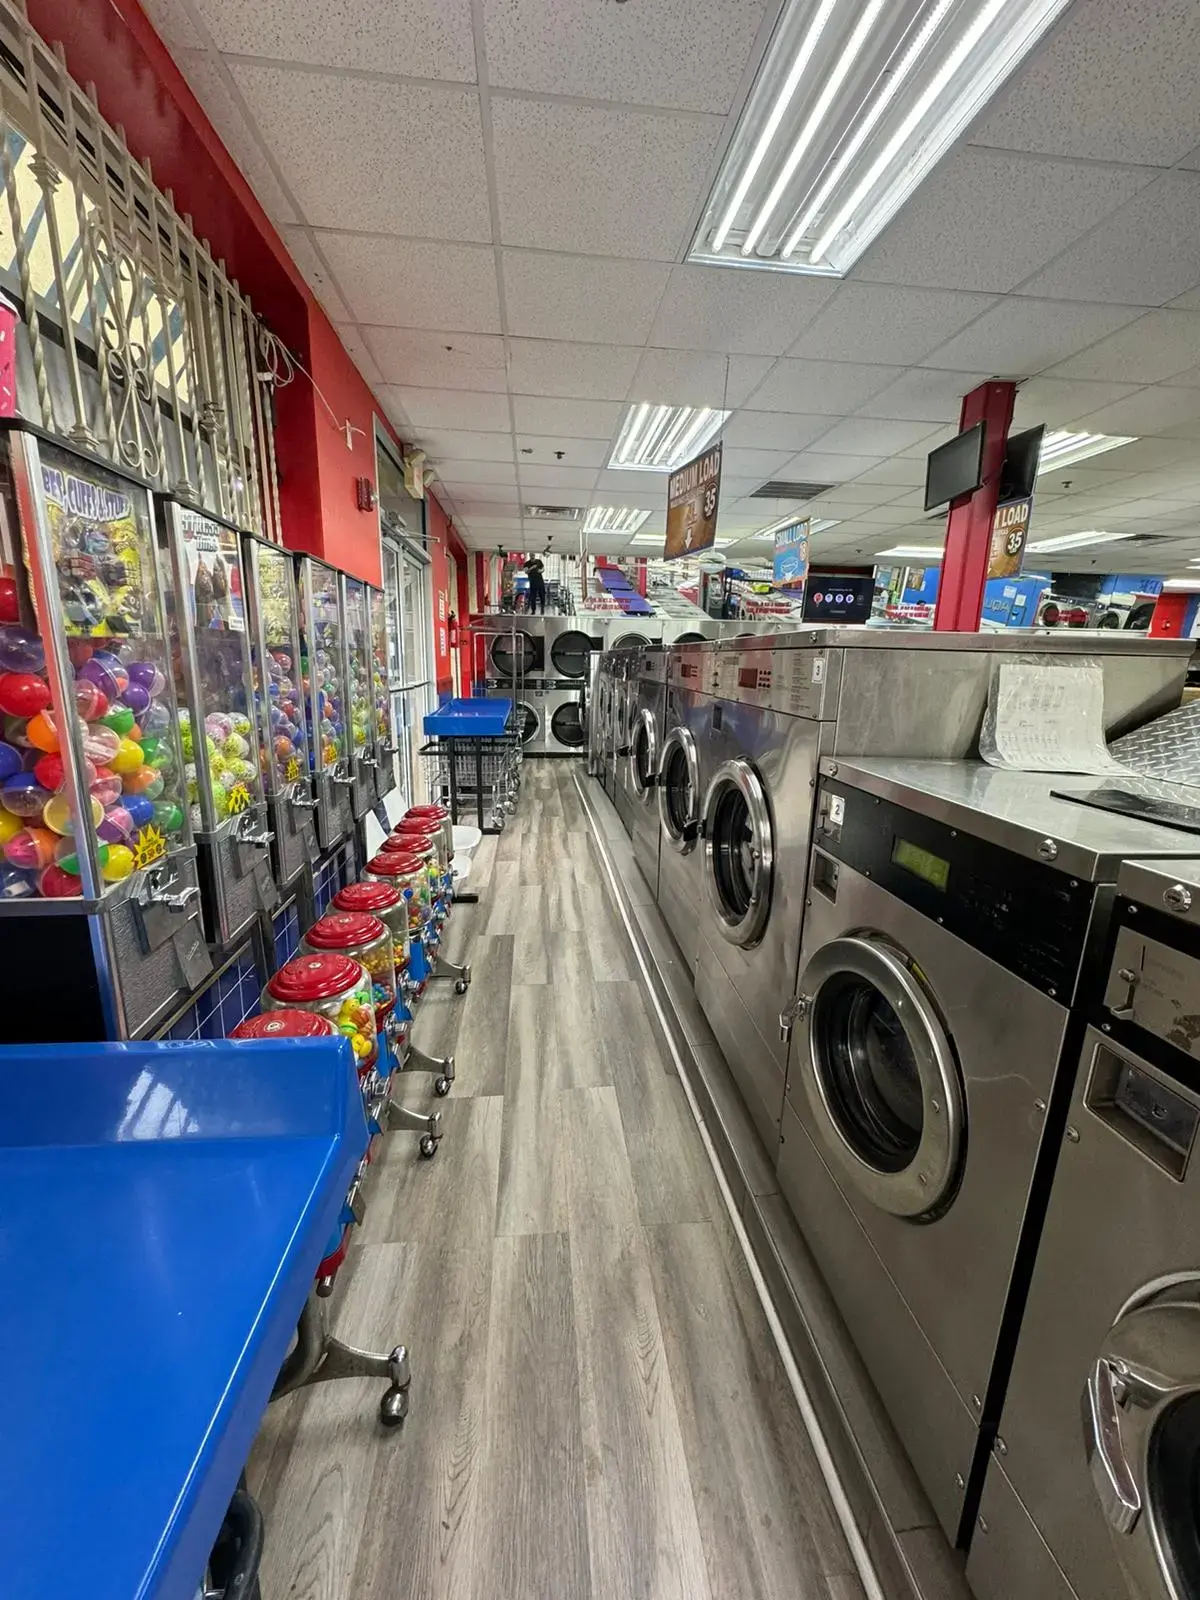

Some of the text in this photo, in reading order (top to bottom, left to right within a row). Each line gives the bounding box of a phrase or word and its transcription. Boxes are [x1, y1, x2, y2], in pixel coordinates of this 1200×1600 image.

[670, 464, 698, 500] MEDIUM
[700, 451, 720, 482] LOAD
[1002, 504, 1028, 527] LOAD
[1008, 531, 1022, 550] 35
[835, 804, 840, 815] 2
